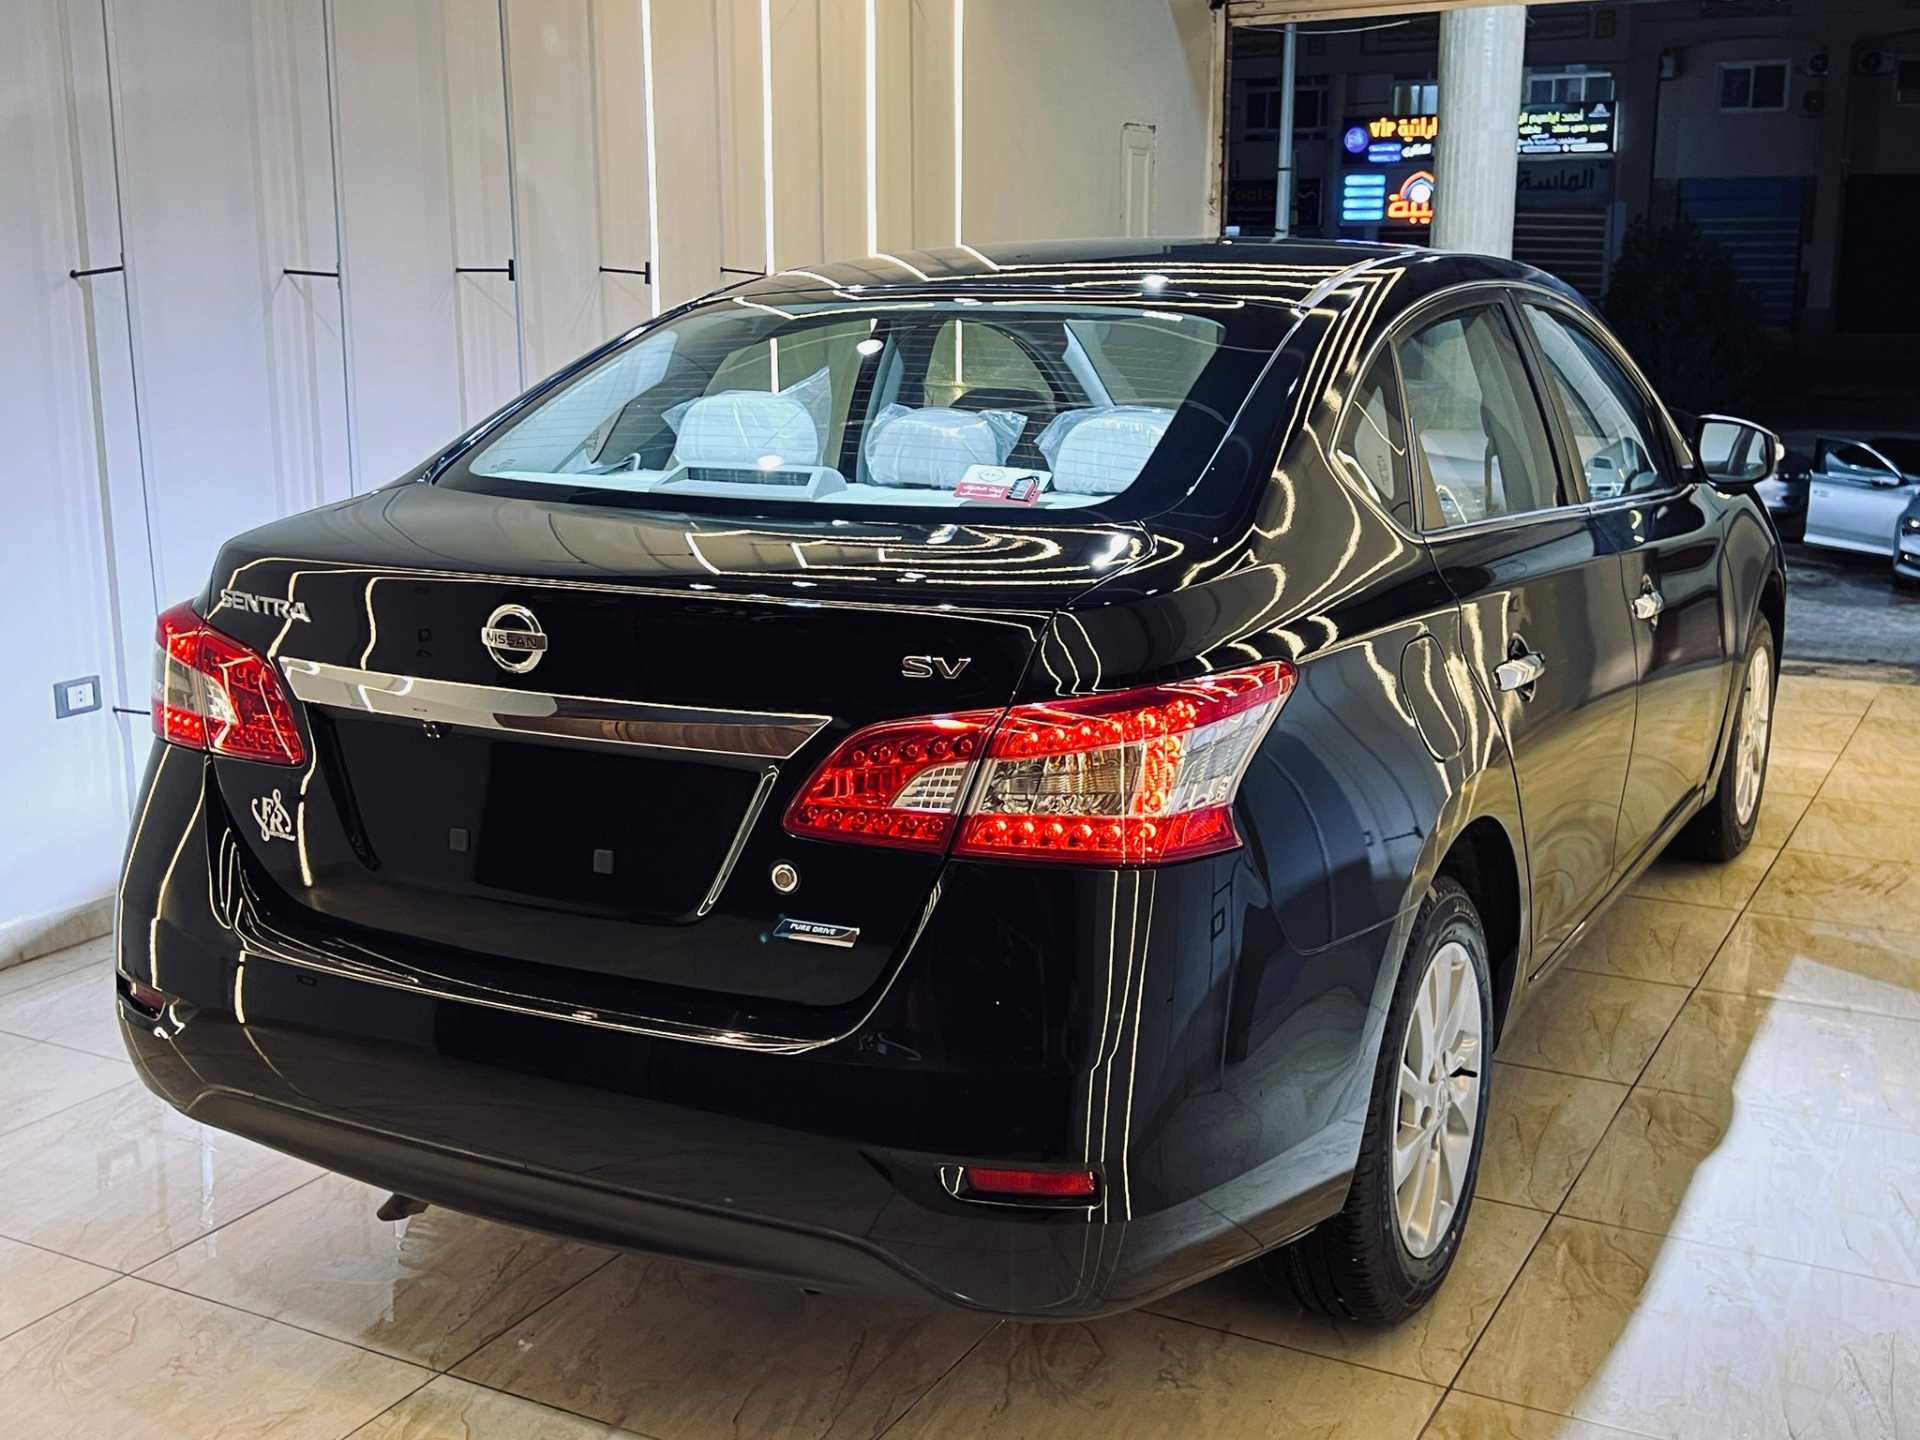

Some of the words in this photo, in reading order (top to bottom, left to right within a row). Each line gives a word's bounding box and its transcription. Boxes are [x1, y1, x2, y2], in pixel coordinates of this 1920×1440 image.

[220, 588, 312, 623] SENTRA
[486, 632, 537, 647] NISSAN
[901, 655, 971, 680] SV
[789, 923, 811, 932] PURE
[812, 926, 838, 935] DRIVE
